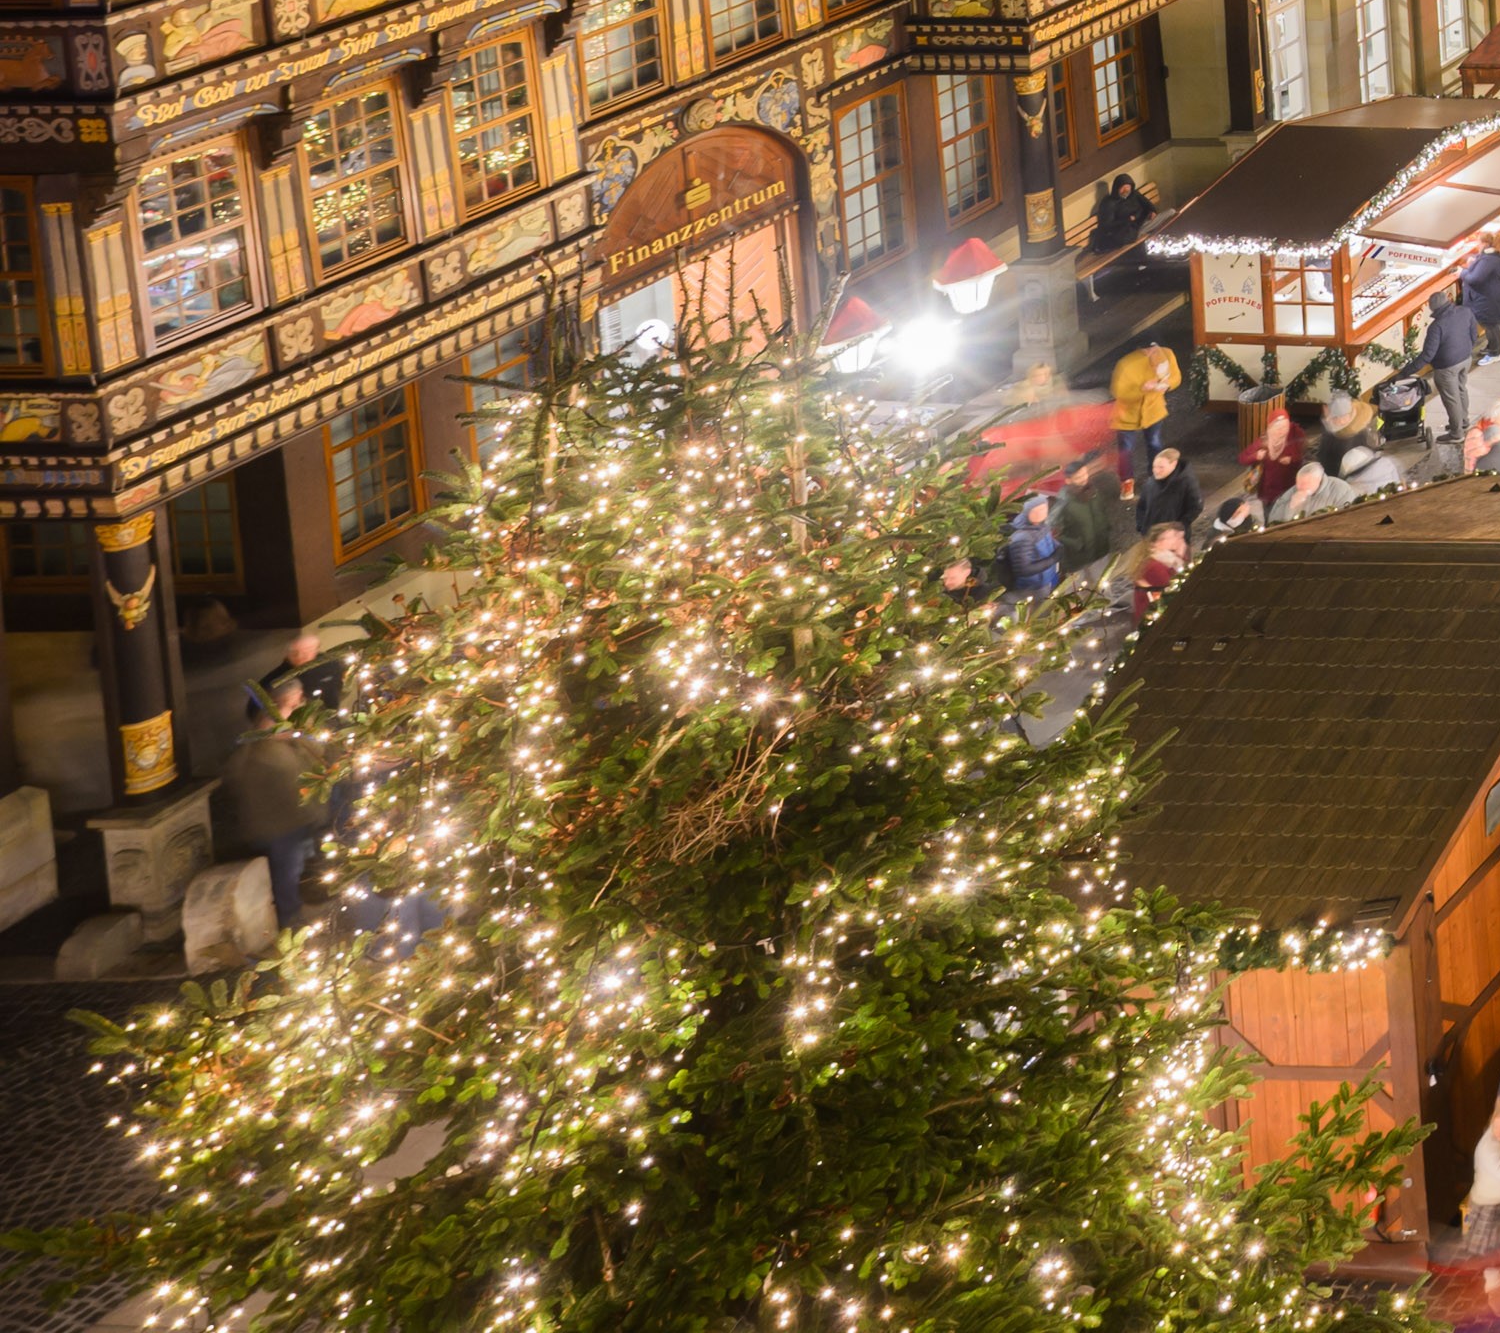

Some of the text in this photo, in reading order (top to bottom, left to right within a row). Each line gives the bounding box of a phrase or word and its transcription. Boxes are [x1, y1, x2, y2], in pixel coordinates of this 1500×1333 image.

[608, 180, 787, 276] Finanzzentrum
[1388, 250, 1439, 264] POFFERTJES
[1205, 295, 1263, 311] POFFERTJES
